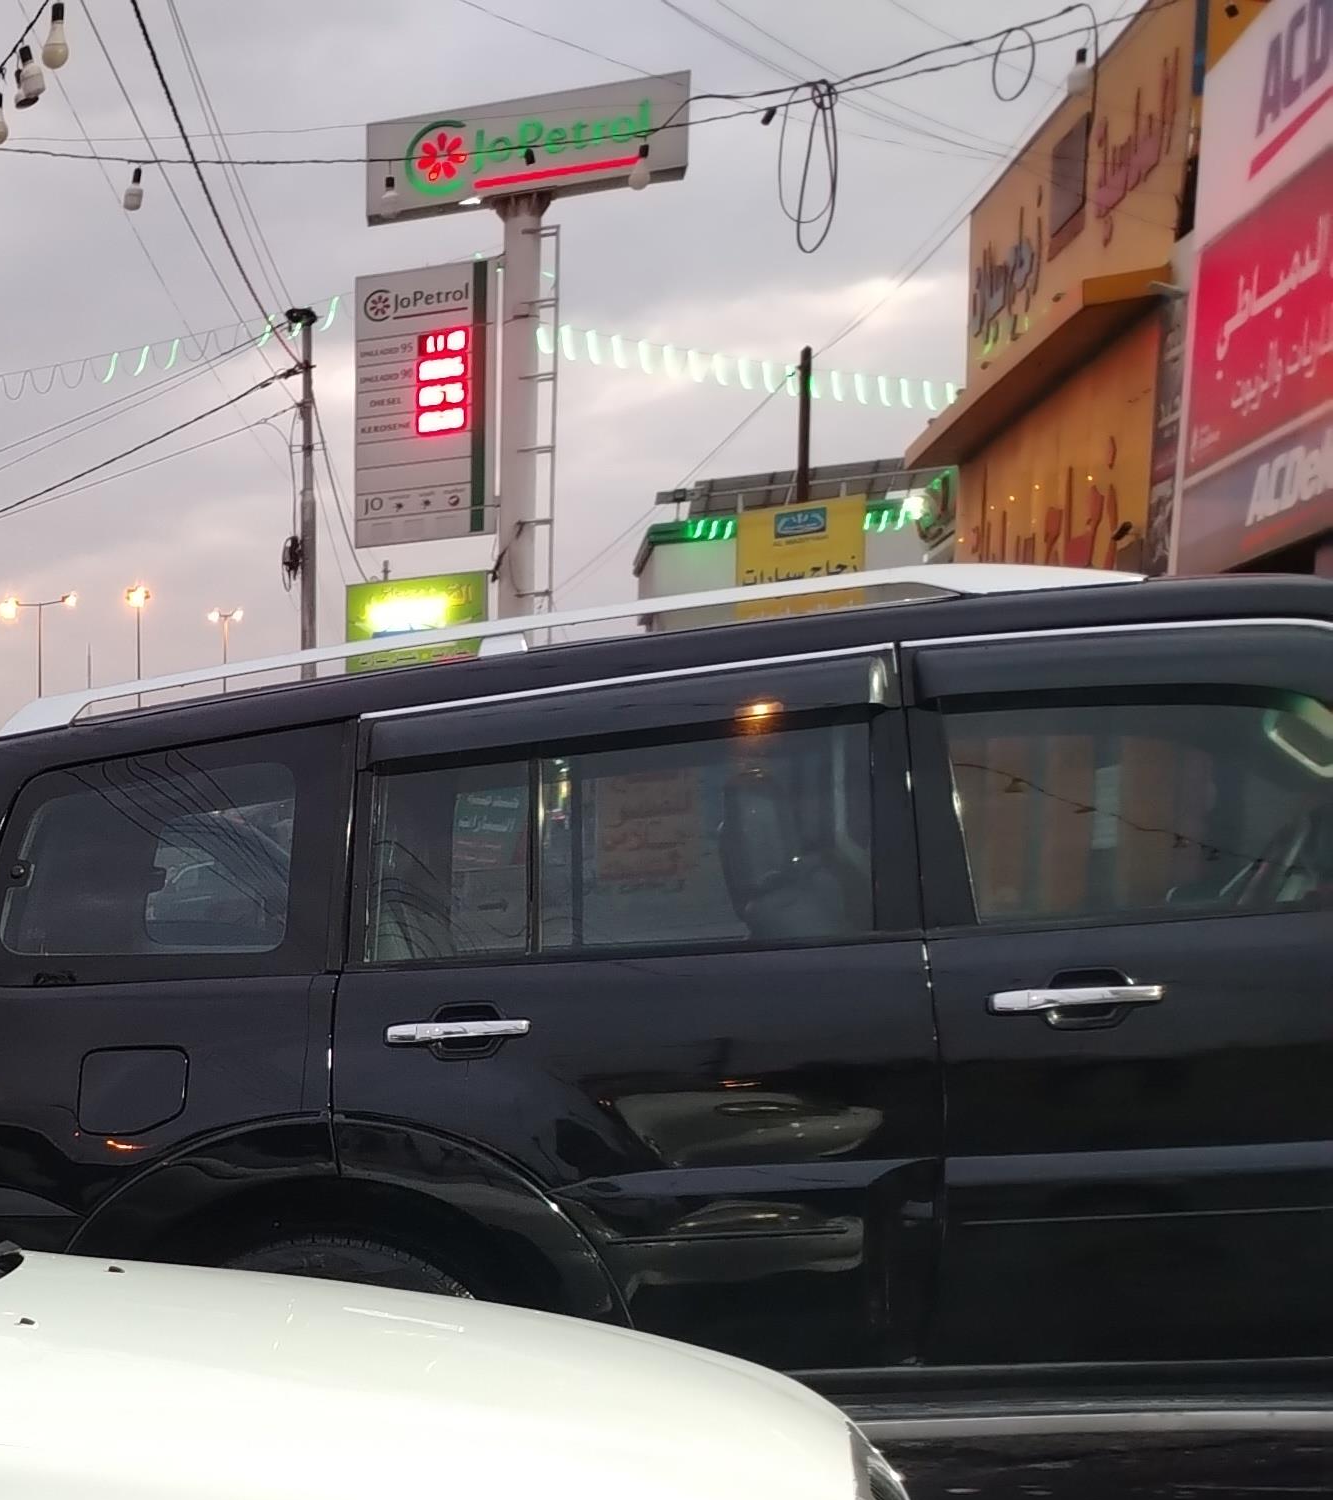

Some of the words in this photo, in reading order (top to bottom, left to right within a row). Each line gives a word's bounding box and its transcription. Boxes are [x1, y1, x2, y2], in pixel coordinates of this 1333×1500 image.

[471, 97, 652, 174] JoPetrol
[393, 282, 470, 314] JoPetrol
[400, 342, 414, 354] 95
